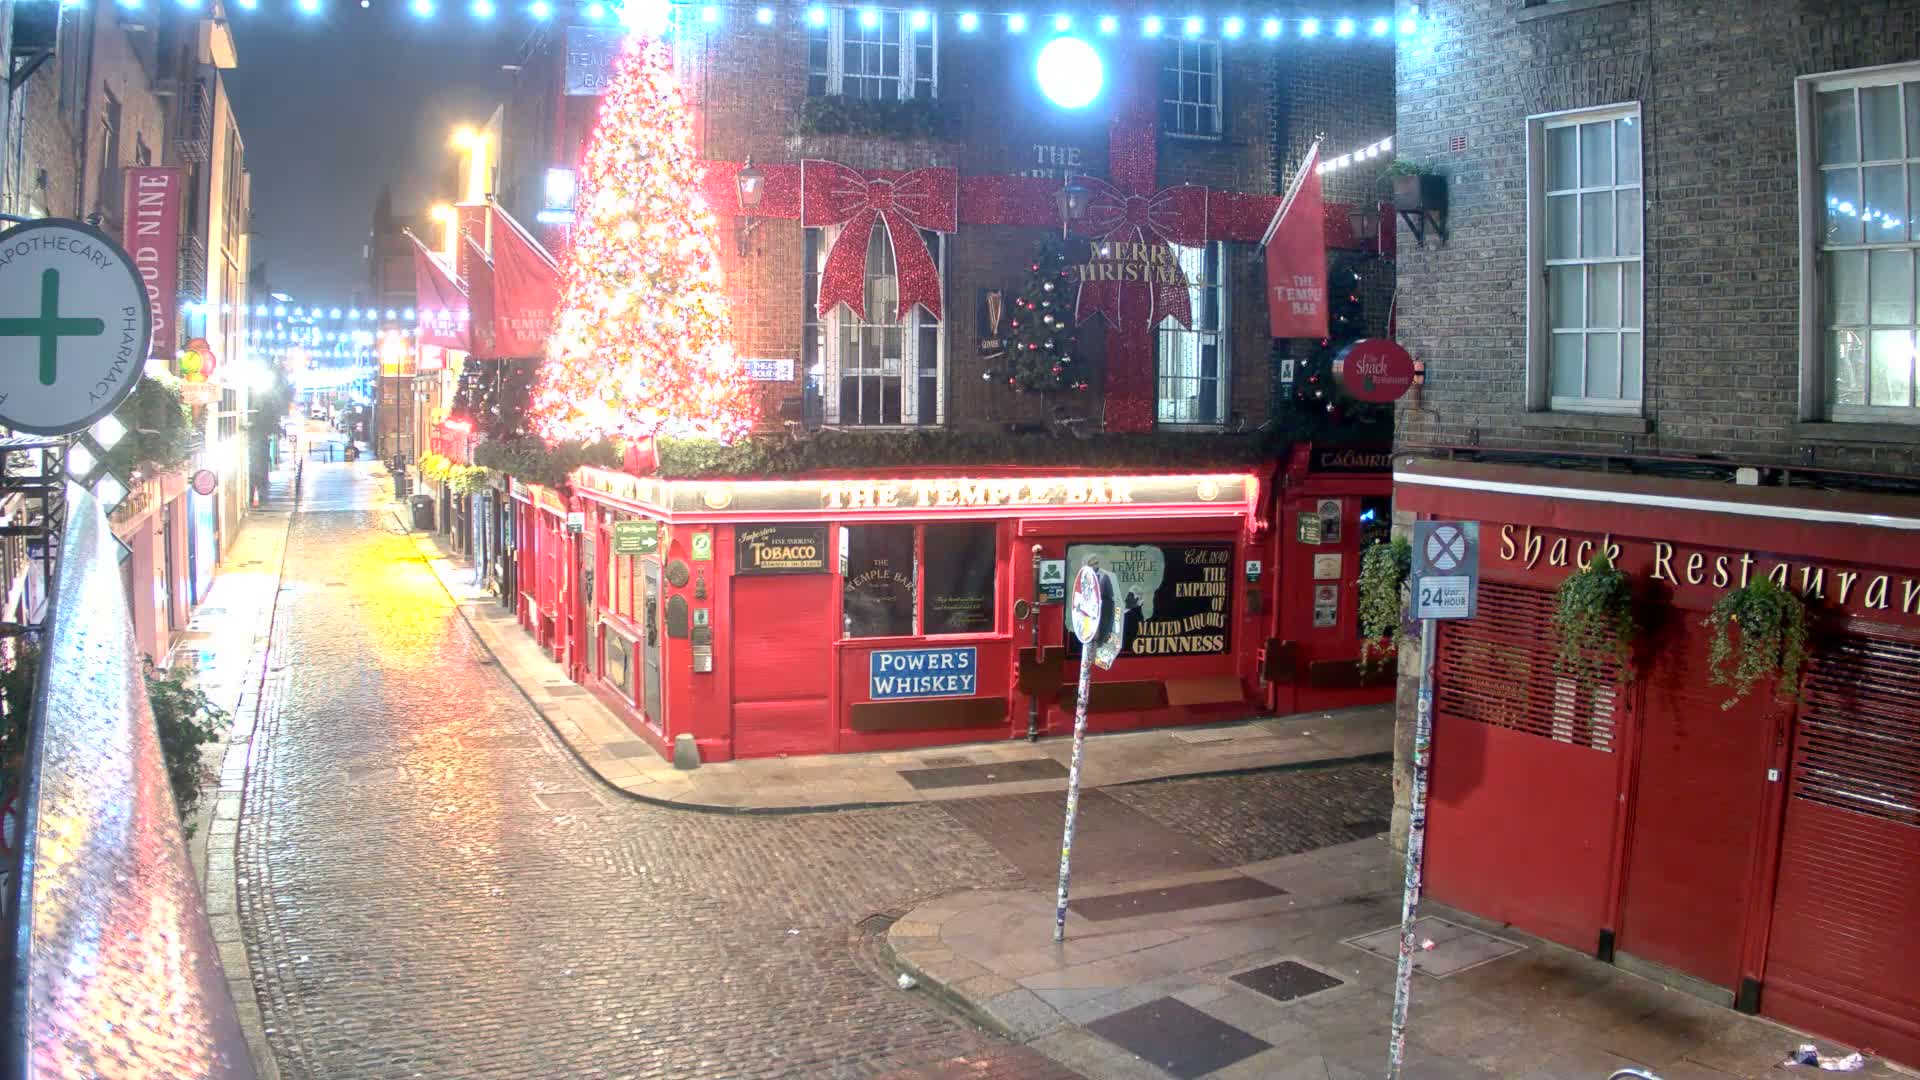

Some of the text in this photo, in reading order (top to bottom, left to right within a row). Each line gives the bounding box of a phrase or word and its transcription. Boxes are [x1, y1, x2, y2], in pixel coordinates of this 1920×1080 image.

[570, 52, 613, 66] TEMP
[1033, 144, 1081, 166] THE
[137, 175, 169, 236] NINE
[0, 236, 113, 270] APOTHECARY
[1090, 241, 1179, 265] MERRY
[1065, 263, 1207, 291] CHRISTMAS
[1292, 302, 1315, 314] BAR
[89, 306, 137, 405] PHARMACY
[820, 480, 899, 508] THE
[749, 542, 816, 567] TOBACCO
[1123, 550, 1147, 562] THE
[1111, 561, 1157, 572] TEMPLE
[1203, 567, 1226, 582] THE
[1500, 524, 1920, 614] Shack Restauran
[848, 569, 913, 592] TEMPLE BAR
[1121, 572, 1145, 583] BAR
[1175, 582, 1226, 598] EMPEROR
[1421, 587, 1443, 607] 24
[1211, 597, 1225, 612] OF
[1444, 597, 1466, 606] HOUR
[1137, 612, 1225, 636] MALTED LIQUORS
[1132, 635, 1224, 655] GUINNESS
[879, 652, 968, 672] POWER'S
[873, 674, 973, 695] WHISKEY
